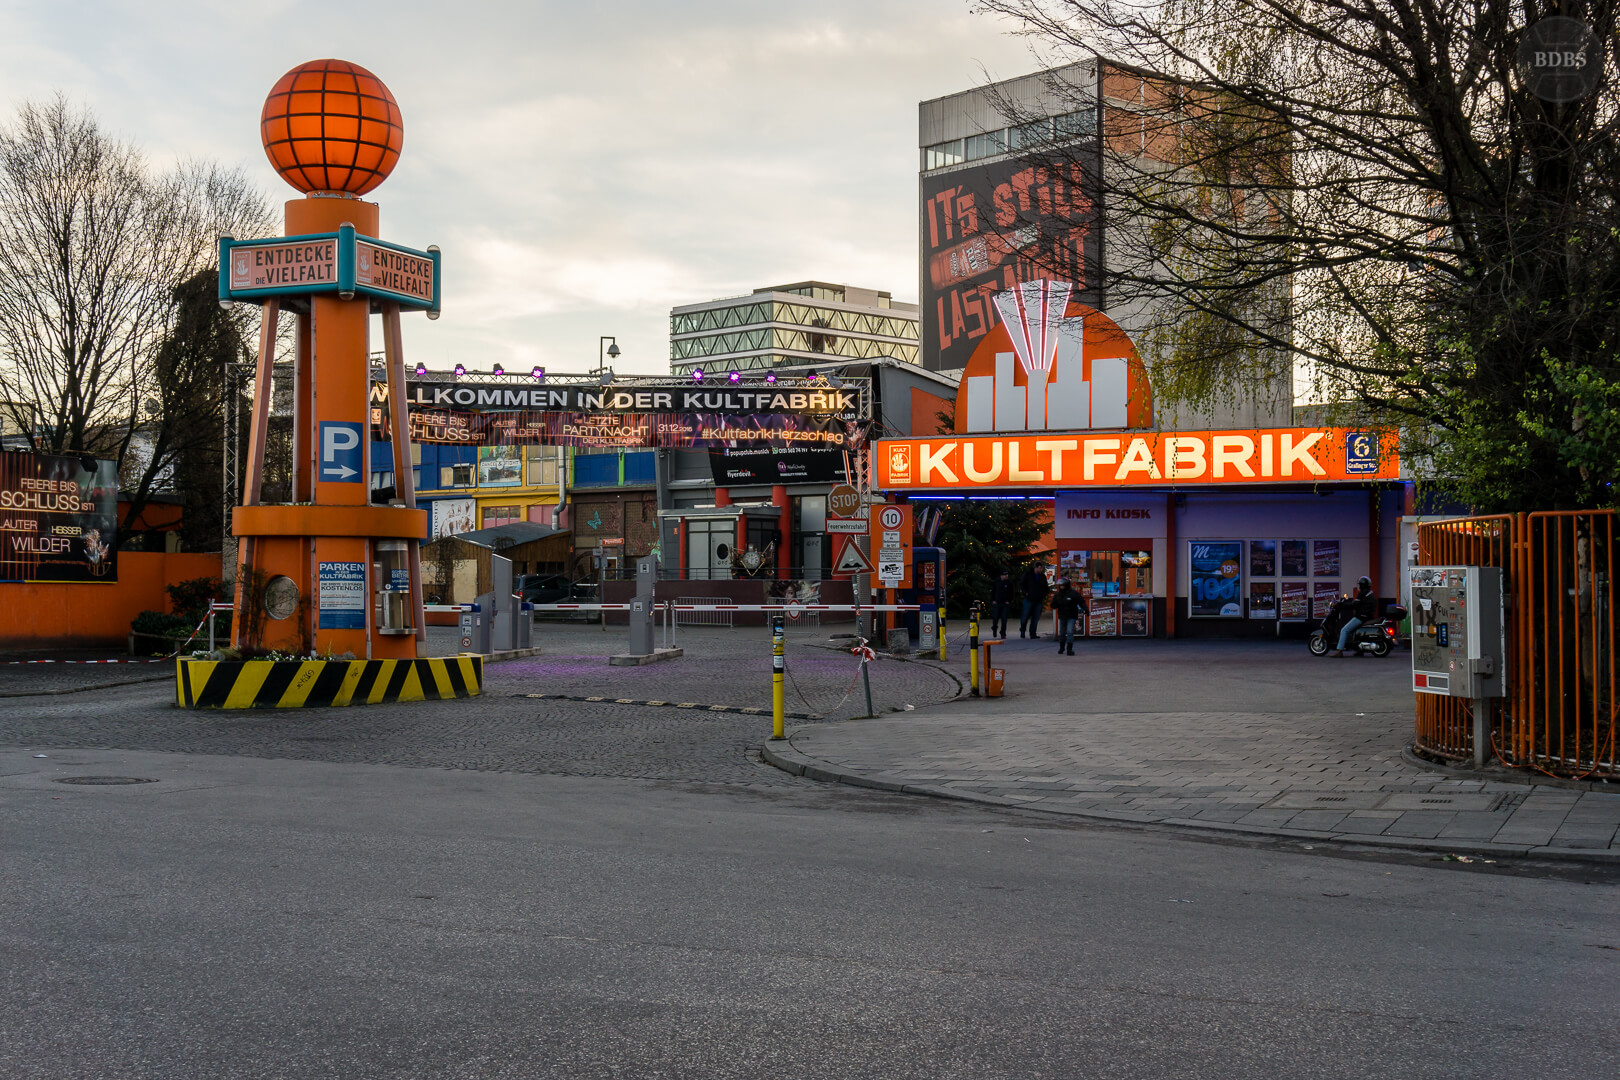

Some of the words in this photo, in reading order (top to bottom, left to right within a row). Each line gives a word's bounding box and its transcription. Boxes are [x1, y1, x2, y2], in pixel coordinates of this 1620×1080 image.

[255, 244, 333, 266] ENTDECKE
[373, 249, 430, 278] ENTDECKE
[255, 277, 265, 285] DIE
[265, 263, 333, 284] VIELFALT
[373, 276, 382, 286] DIE
[381, 270, 430, 297] VIELFALT
[937, 279, 999, 351] LAST
[369, 386, 568, 407] WLKOMMEN
[577, 392, 604, 409] IN
[613, 393, 672, 409] DER
[683, 392, 856, 410] KULTFABRIK
[409, 412, 447, 426] FEIERE
[449, 416, 467, 428] BIS
[583, 416, 619, 425] LETZTE
[389, 425, 470, 441] HLUSS
[503, 428, 540, 437] WILDER
[563, 425, 649, 437] PARTYNACHT
[702, 427, 844, 445] #KultfabrikHerzschlag
[323, 426, 360, 462] P
[1354, 436, 1370, 457] 6
[919, 432, 1327, 484] KULTFABRIK
[20, 478, 58, 491] FEIERE
[59, 481, 77, 492] BIS
[1, 490, 80, 511] SCHLUSS
[832, 493, 858, 508] STOP
[885, 513, 898, 525] 10
[1067, 508, 1101, 519] INFO
[1105, 508, 1151, 519] KIOSK
[828, 521, 867, 531] Feuerwehrzufahrt
[12, 536, 71, 552] WILDER
[319, 563, 365, 572] PARKEN
